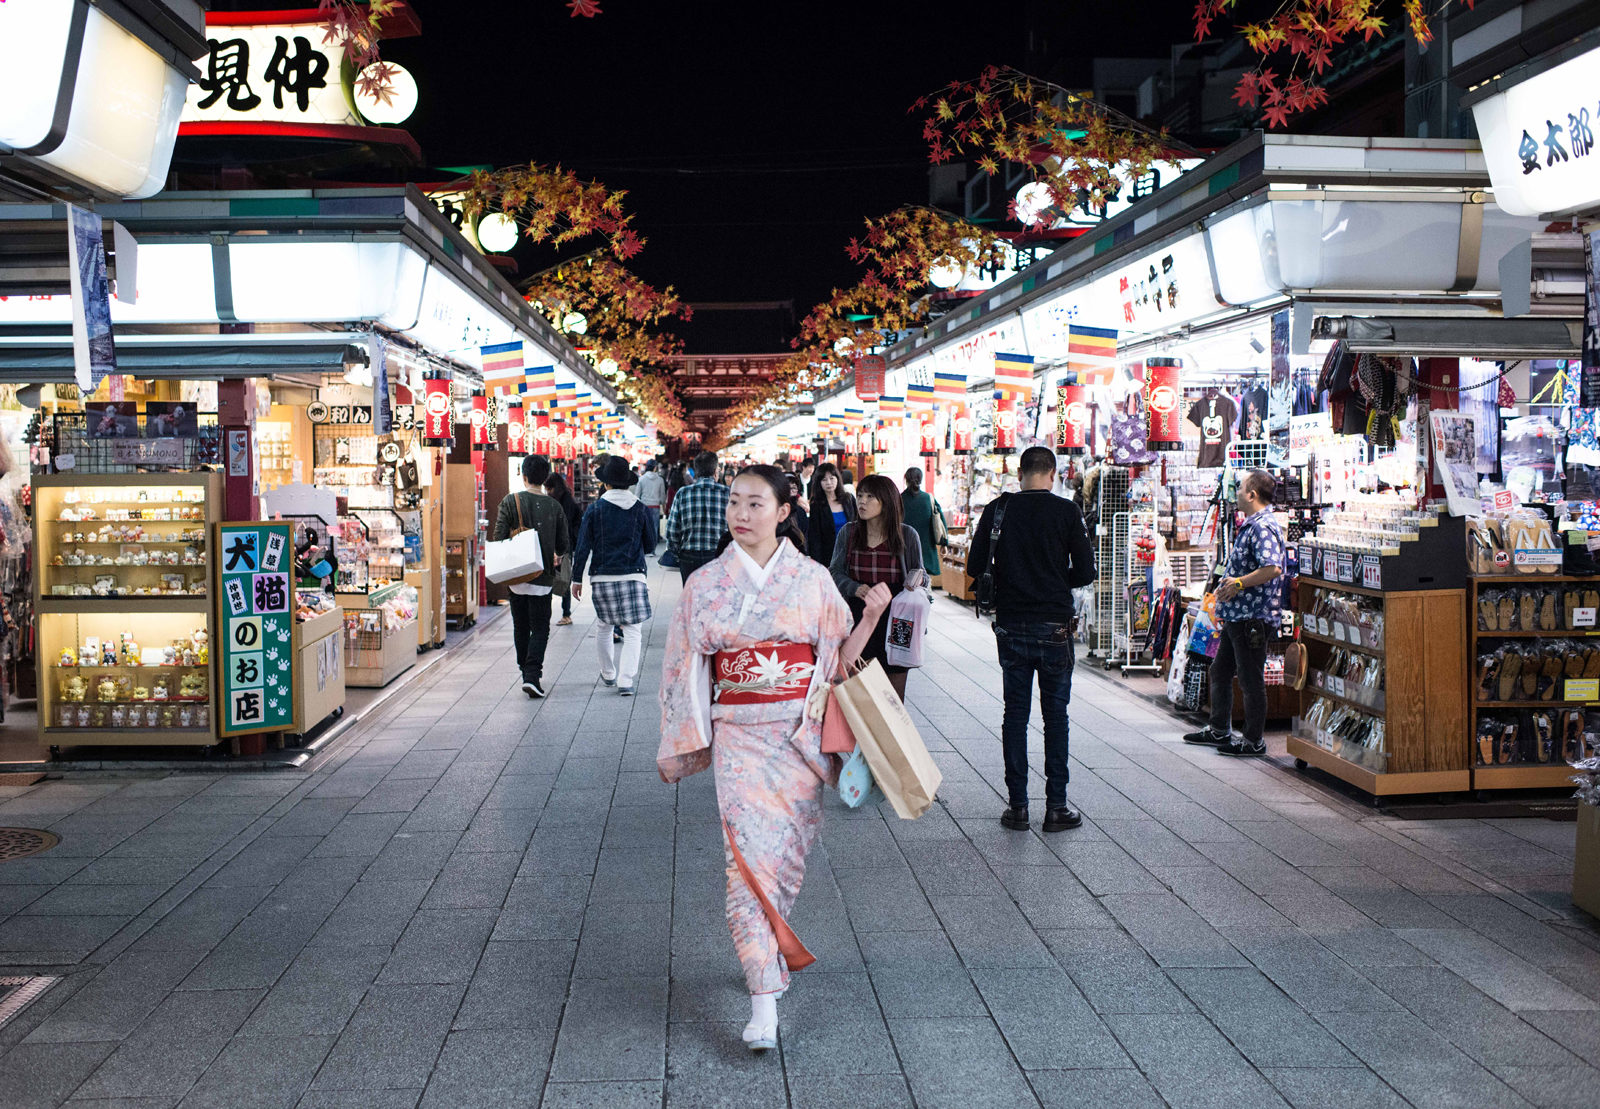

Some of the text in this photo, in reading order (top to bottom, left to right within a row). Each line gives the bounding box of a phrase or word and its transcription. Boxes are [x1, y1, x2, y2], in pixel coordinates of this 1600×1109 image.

[1518, 100, 1600, 176] 金太郎
[229, 583, 243, 611] 仲見世
